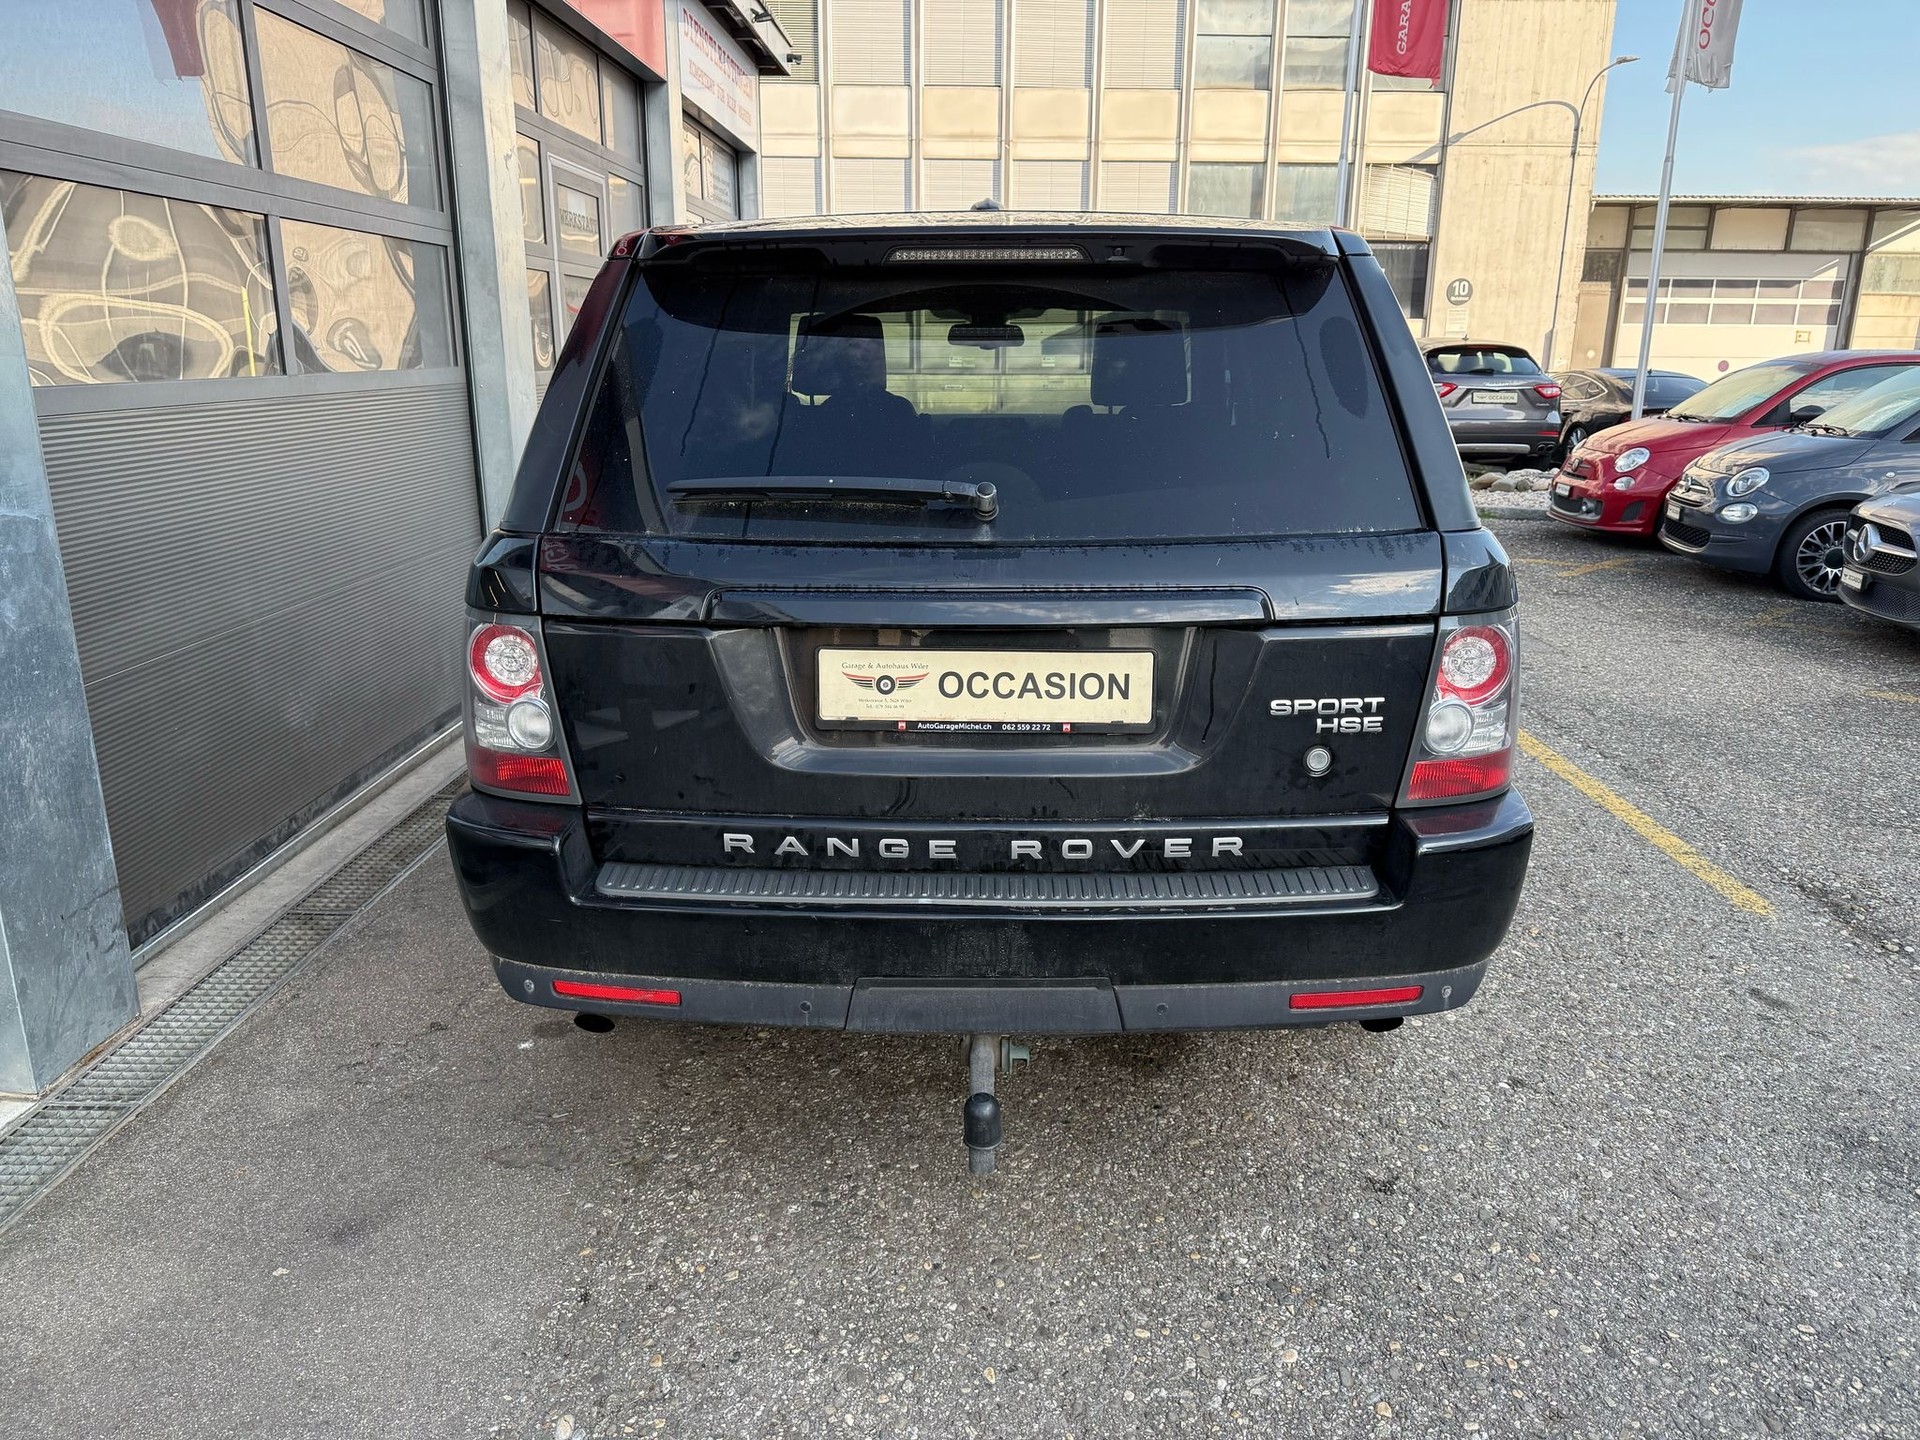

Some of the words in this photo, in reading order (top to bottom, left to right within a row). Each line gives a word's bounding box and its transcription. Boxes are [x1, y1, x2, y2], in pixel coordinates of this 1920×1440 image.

[1452, 280, 1470, 296] 10
[841, 661, 866, 670] Garage
[938, 671, 1131, 701] OCCASION
[1269, 697, 1386, 716] SPORT
[917, 721, 992, 732] AutoGarageMichel.ch
[1001, 723, 1016, 731] 062
[1017, 723, 1030, 731] 559
[1031, 723, 1041, 731] 22
[1042, 723, 1051, 731] 72
[1316, 716, 1384, 734] HSE
[723, 832, 958, 859] RANGE
[1010, 836, 1244, 860] ROVER
